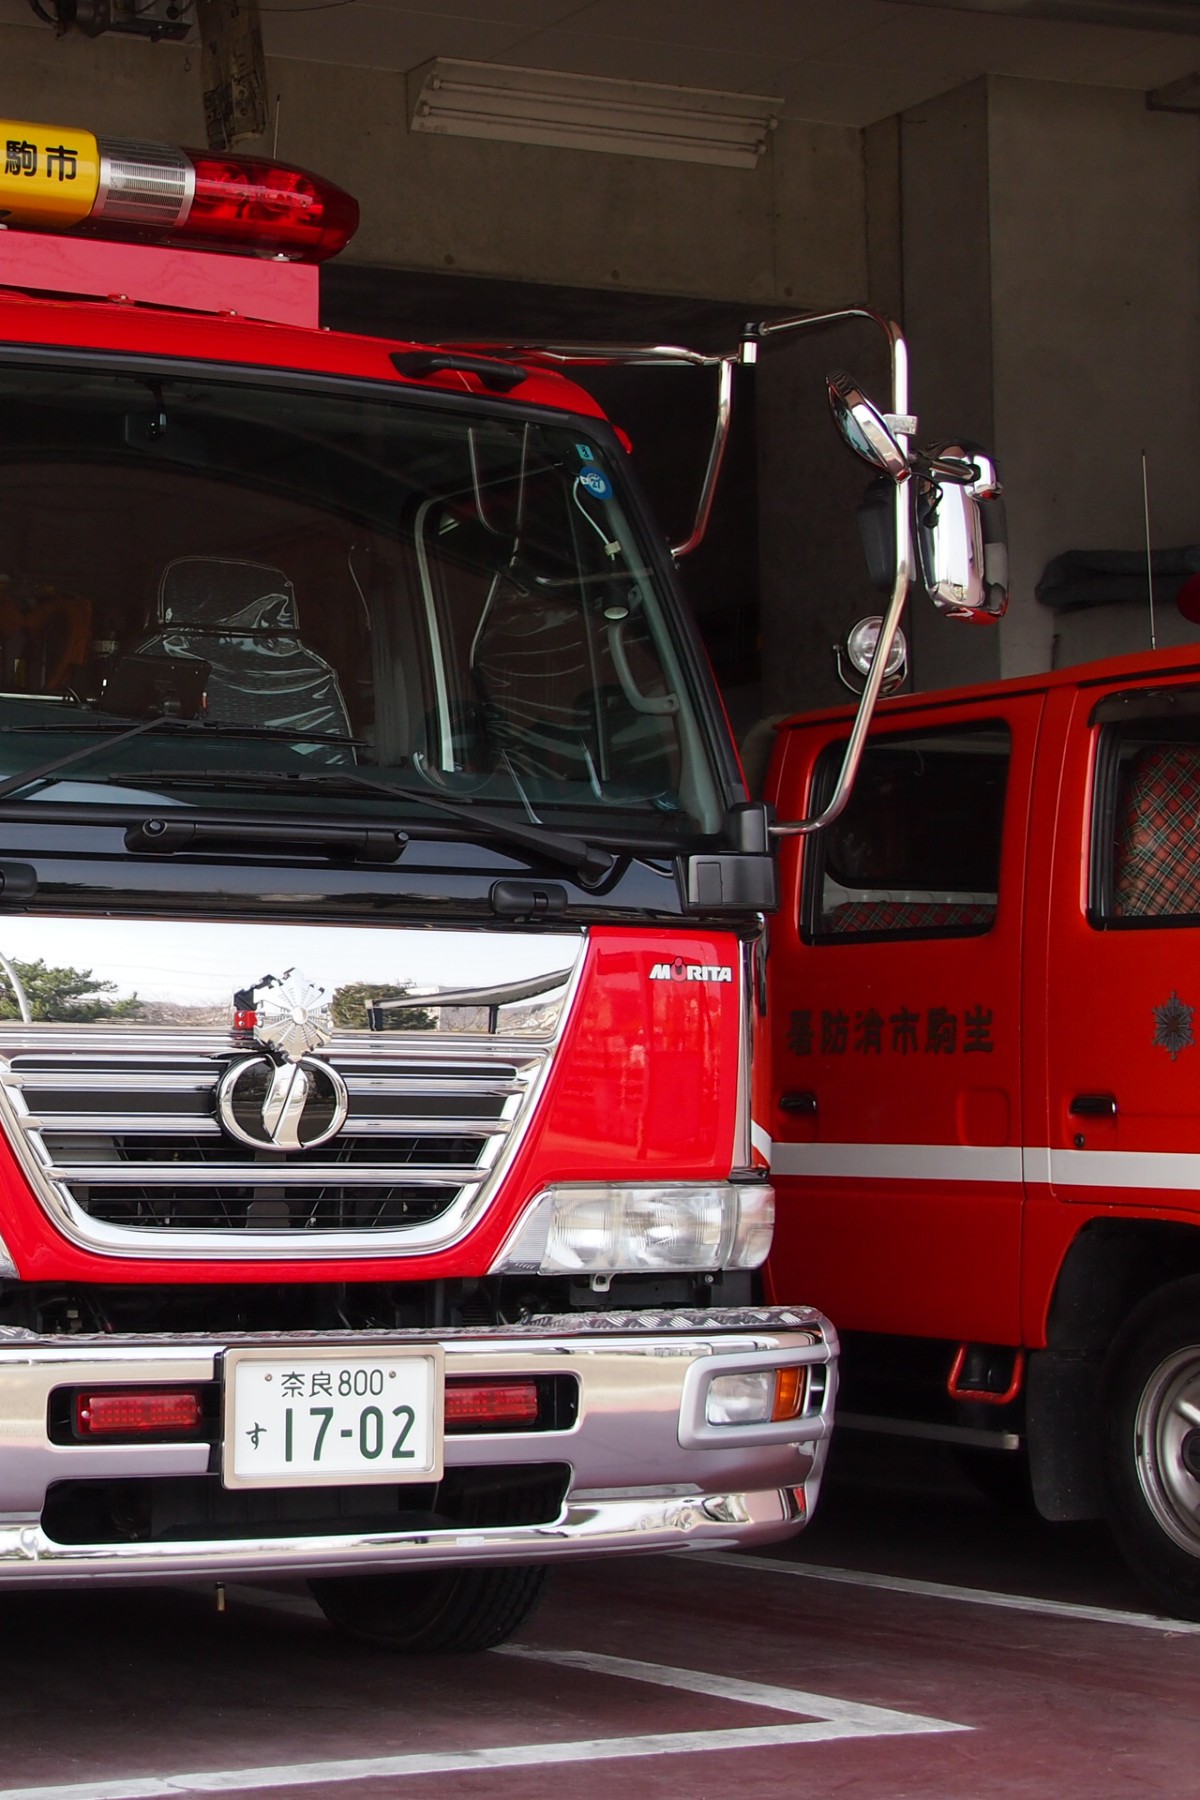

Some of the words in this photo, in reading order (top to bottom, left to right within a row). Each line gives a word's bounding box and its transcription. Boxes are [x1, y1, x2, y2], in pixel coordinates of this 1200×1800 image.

[648, 957, 732, 982] MORITA
[245, 1422, 267, 1450] す
[285, 1405, 416, 1462] 17-02
